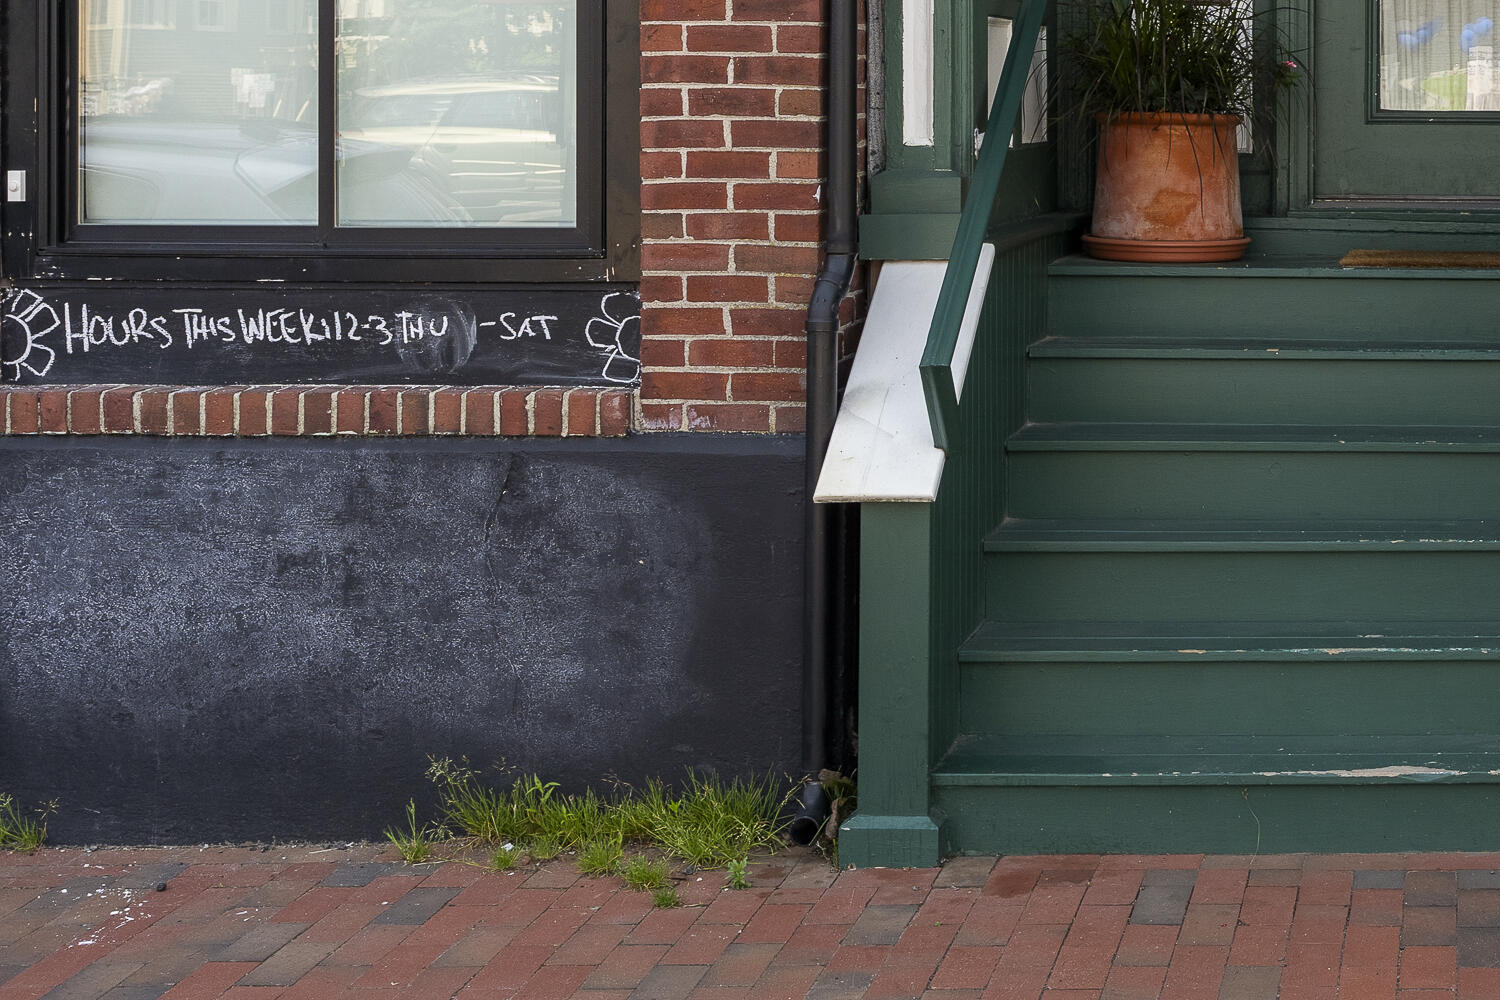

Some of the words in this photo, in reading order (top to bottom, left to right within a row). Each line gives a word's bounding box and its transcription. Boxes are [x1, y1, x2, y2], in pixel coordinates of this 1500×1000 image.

[64, 302, 173, 354] HOURS
[171, 307, 236, 349] THIS
[396, 310, 448, 344] THU
